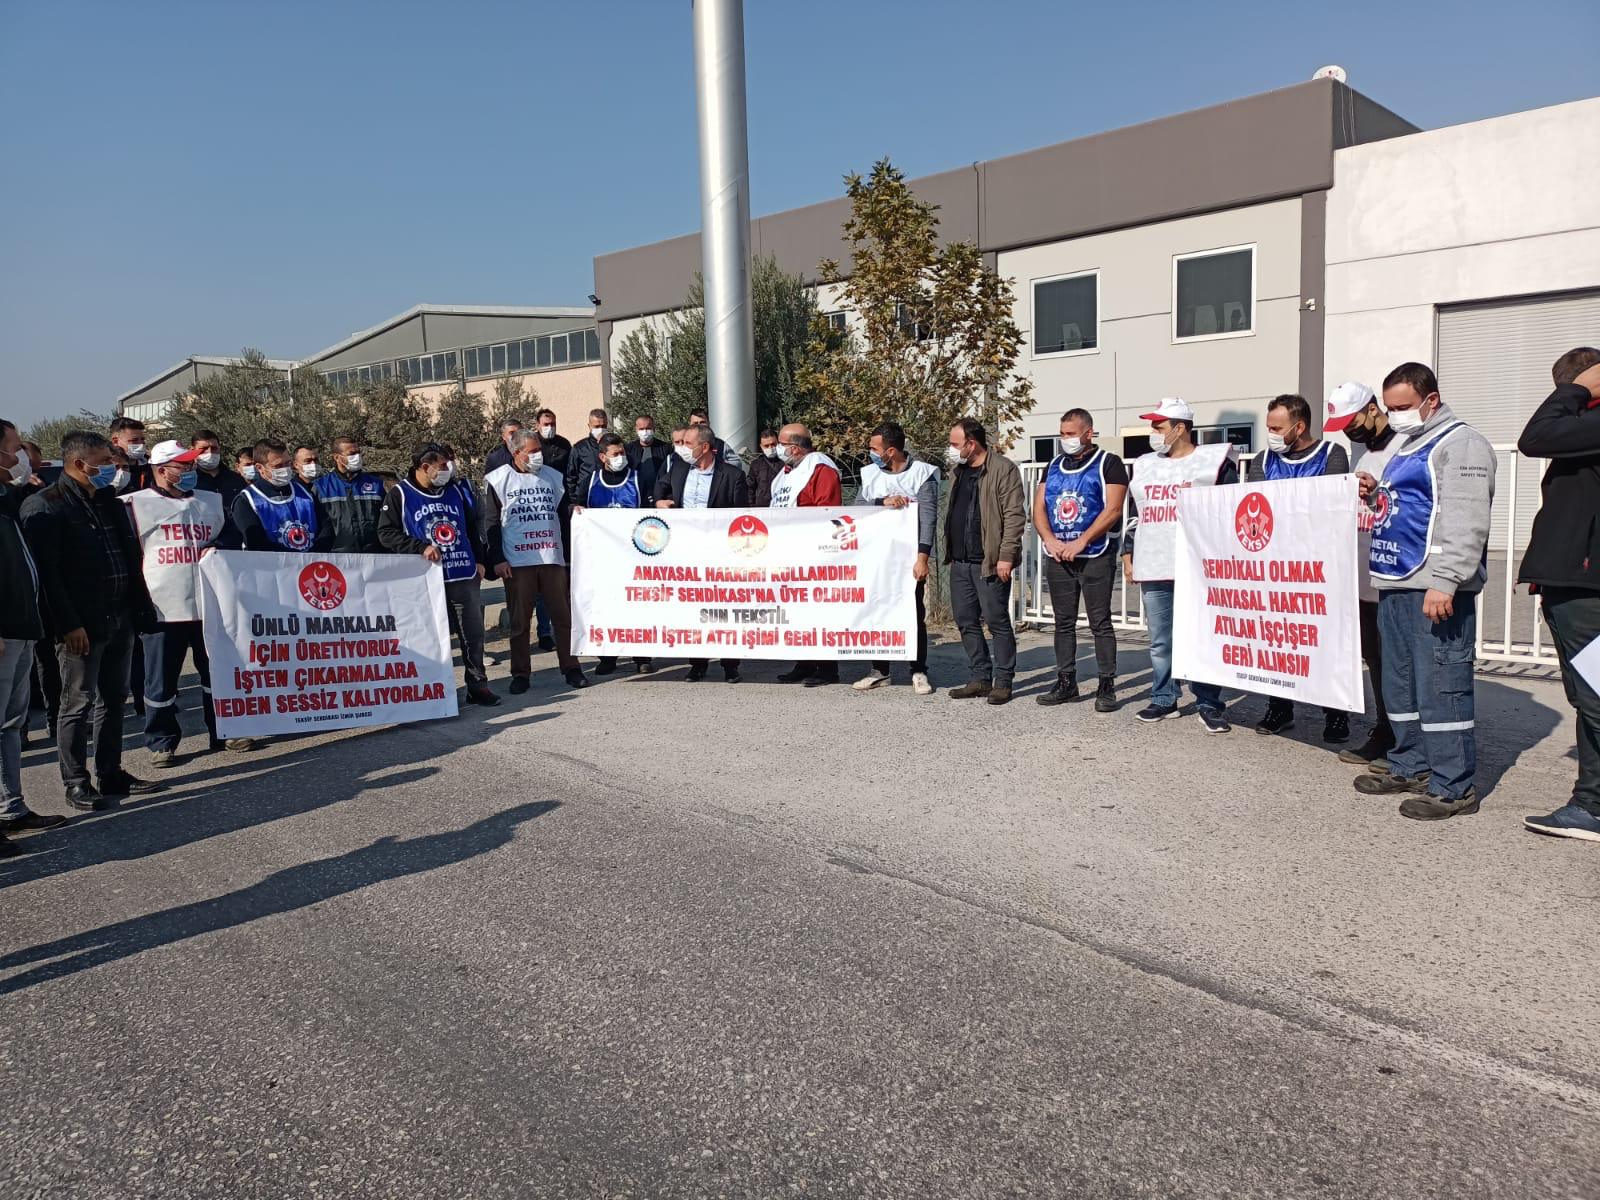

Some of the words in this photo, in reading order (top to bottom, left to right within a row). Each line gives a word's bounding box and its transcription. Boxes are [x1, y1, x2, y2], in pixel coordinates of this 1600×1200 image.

[518, 496, 553, 505] OLMAK
[1144, 483, 1185, 500] TEKS
[1141, 501, 1177, 523] ENDİK
[160, 521, 212, 541] TEKSİF
[158, 542, 202, 564] SENDİK
[633, 566, 701, 581] ANAYASAL
[771, 565, 857, 582] KULLANDIM
[1202, 555, 1265, 581] SENDİKALI
[1269, 560, 1326, 583] OLMAK
[625, 584, 673, 602] TEKSİF
[678, 585, 776, 602] SENDİKASI'NA
[780, 585, 808, 602] ÜYE
[813, 587, 865, 603] OLDUM
[1207, 586, 1266, 611] ANAYASAL
[1269, 591, 1327, 615] HAKTIR
[252, 614, 300, 636] ÜNLÜ
[306, 615, 397, 635] MARKALAR
[700, 608, 728, 623] SUN
[732, 605, 789, 624] TEKSTİL
[590, 625, 603, 646] İŞ
[607, 626, 657, 643] VERENİ
[662, 626, 702, 647] İŞTEN
[706, 630, 737, 645] ATTI
[784, 628, 817, 646] GERİ
[822, 628, 906, 646] İSTİYORUM
[1214, 615, 1256, 639] ATILAN
[1260, 616, 1318, 650] İŞÇİŞER
[249, 640, 290, 667] İÇİN
[296, 638, 400, 661] ÜRETİYORUZ
[1222, 643, 1253, 667] GERİ
[1257, 649, 1310, 677] ALINSIN
[234, 667, 288, 694] İŞTEN
[295, 661, 419, 691] ÇIKARMALARA
[276, 688, 338, 713] SESSİZ
[343, 683, 446, 708] KALIYORLAR
